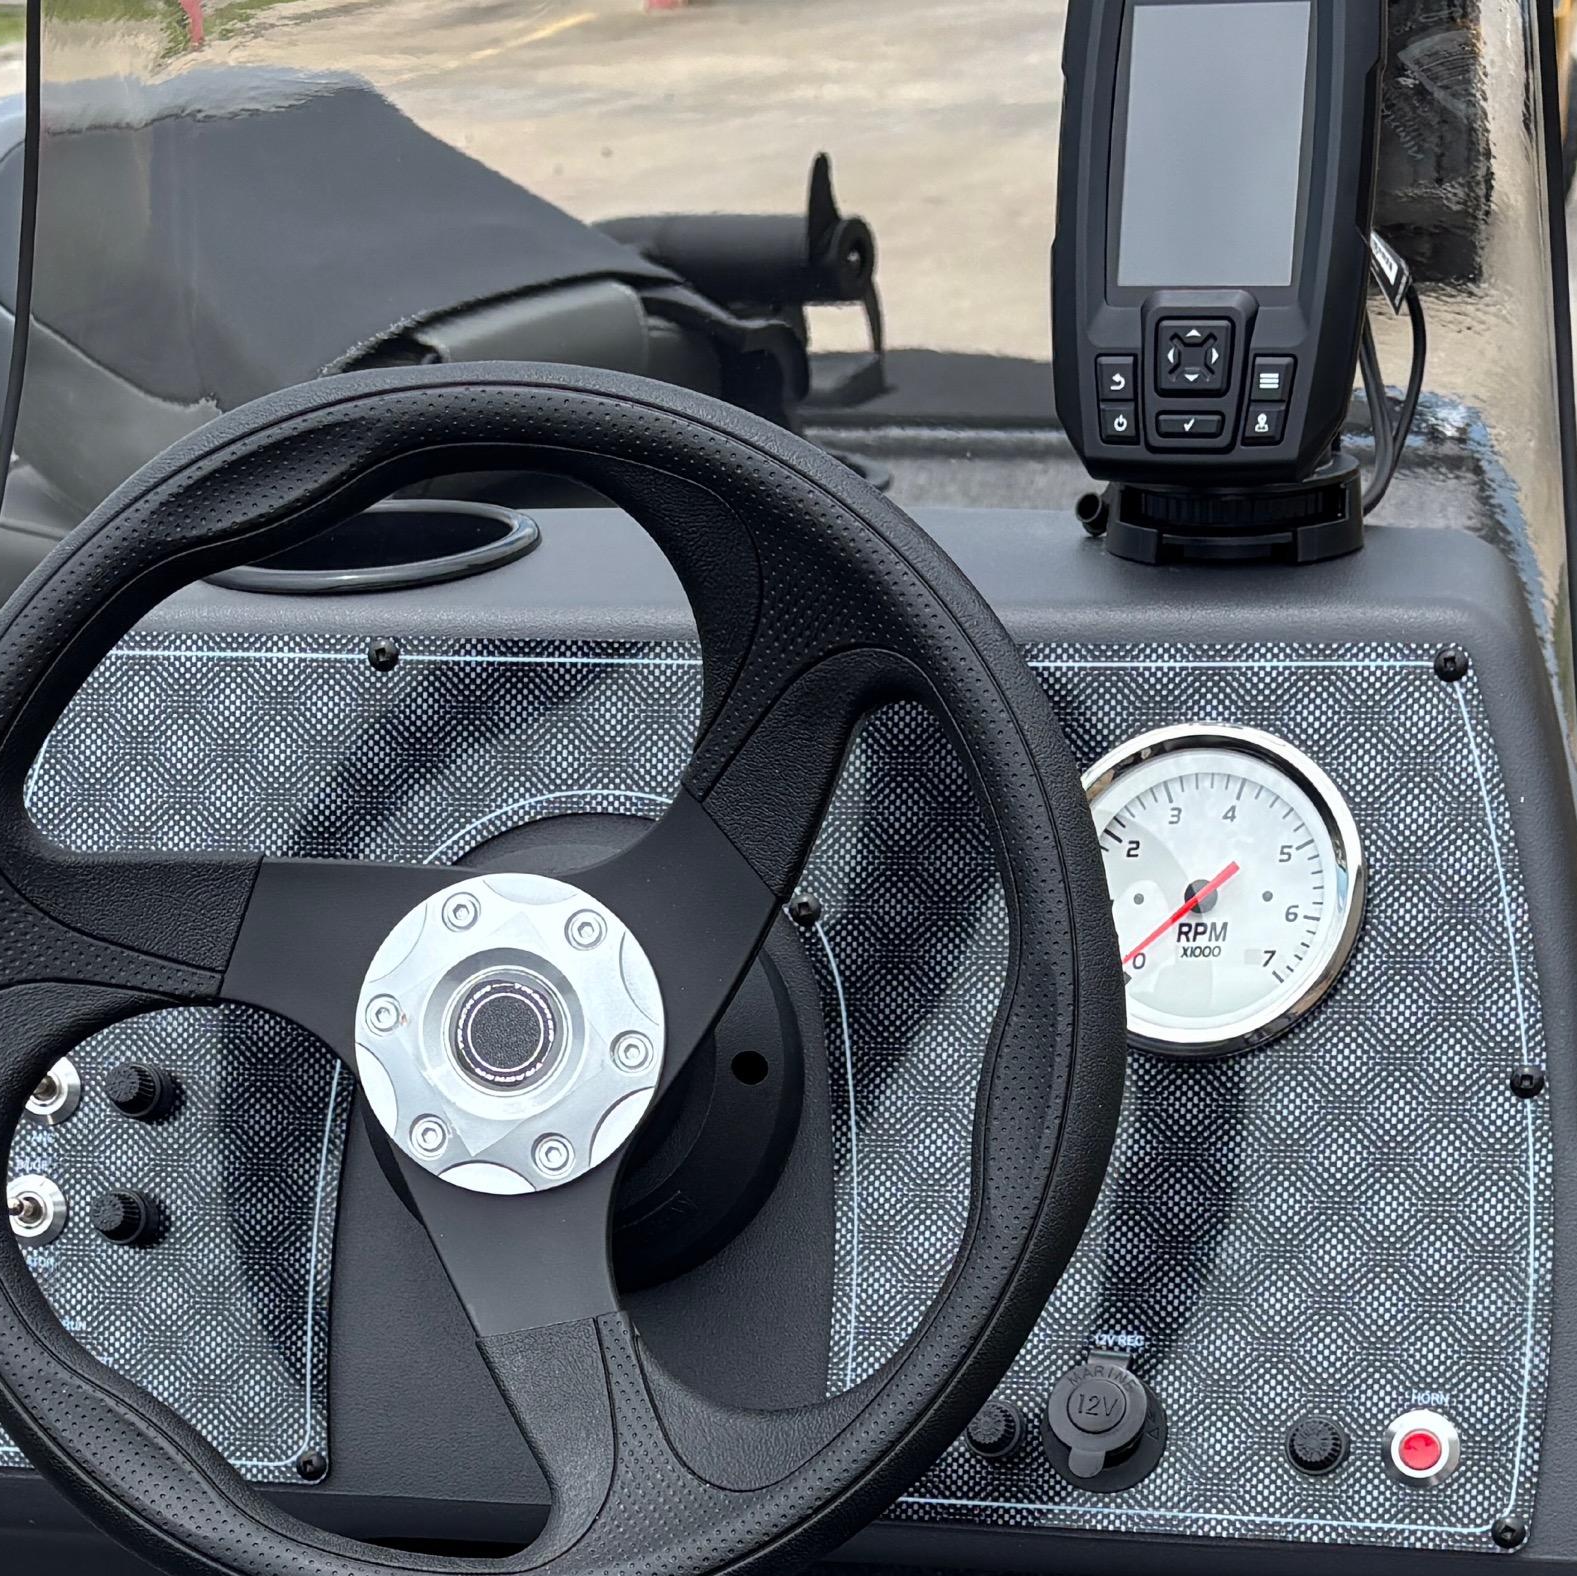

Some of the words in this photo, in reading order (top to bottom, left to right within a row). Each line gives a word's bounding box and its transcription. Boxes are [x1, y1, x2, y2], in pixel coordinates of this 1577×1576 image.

[1168, 806, 1182, 825] 3
[1222, 804, 1238, 822] 4
[1126, 840, 1140, 858] 2
[1278, 844, 1294, 863] 5
[1284, 904, 1299, 923] 6
[1176, 921, 1228, 943] RPM
[1132, 952, 1146, 970] 0
[1180, 945, 1221, 959] X1000
[1262, 950, 1276, 967] 7
[1094, 1334, 1116, 1346] 12V
[1067, 1365, 1138, 1391] MARINE
[1077, 1393, 1119, 1417] 12V
[1411, 1391, 1450, 1406] HORN
